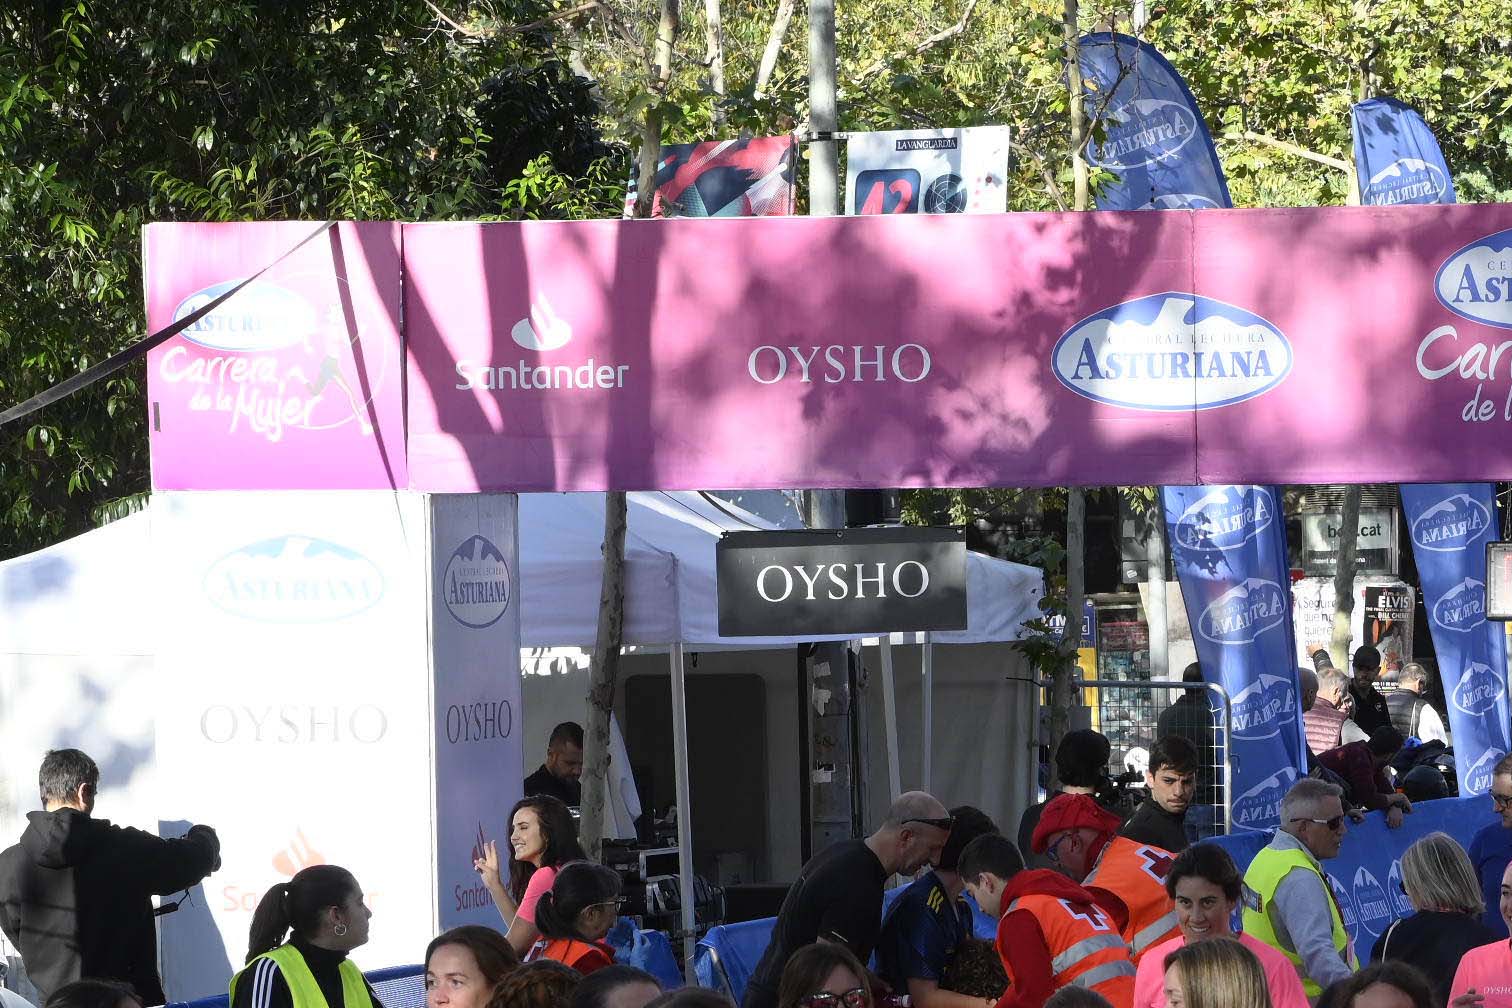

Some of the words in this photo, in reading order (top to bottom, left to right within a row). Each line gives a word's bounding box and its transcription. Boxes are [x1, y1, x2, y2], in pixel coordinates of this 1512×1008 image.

[897, 141, 908, 150] LA
[908, 138, 956, 149] VANGUARDIA
[160, 345, 280, 385] Carrera
[455, 357, 630, 391] Santander
[747, 342, 933, 384] OYSHO
[1071, 336, 1274, 380] ASTURIANA
[229, 378, 325, 443] Mujer
[1461, 384, 1495, 423] de
[449, 576, 507, 606] ASTURIANA
[756, 560, 930, 603] OYSHO
[1378, 595, 1410, 609] ELVIS
[200, 703, 389, 745] OYSHO
[446, 699, 512, 745] OYSHO
[455, 882, 493, 912] Santan
